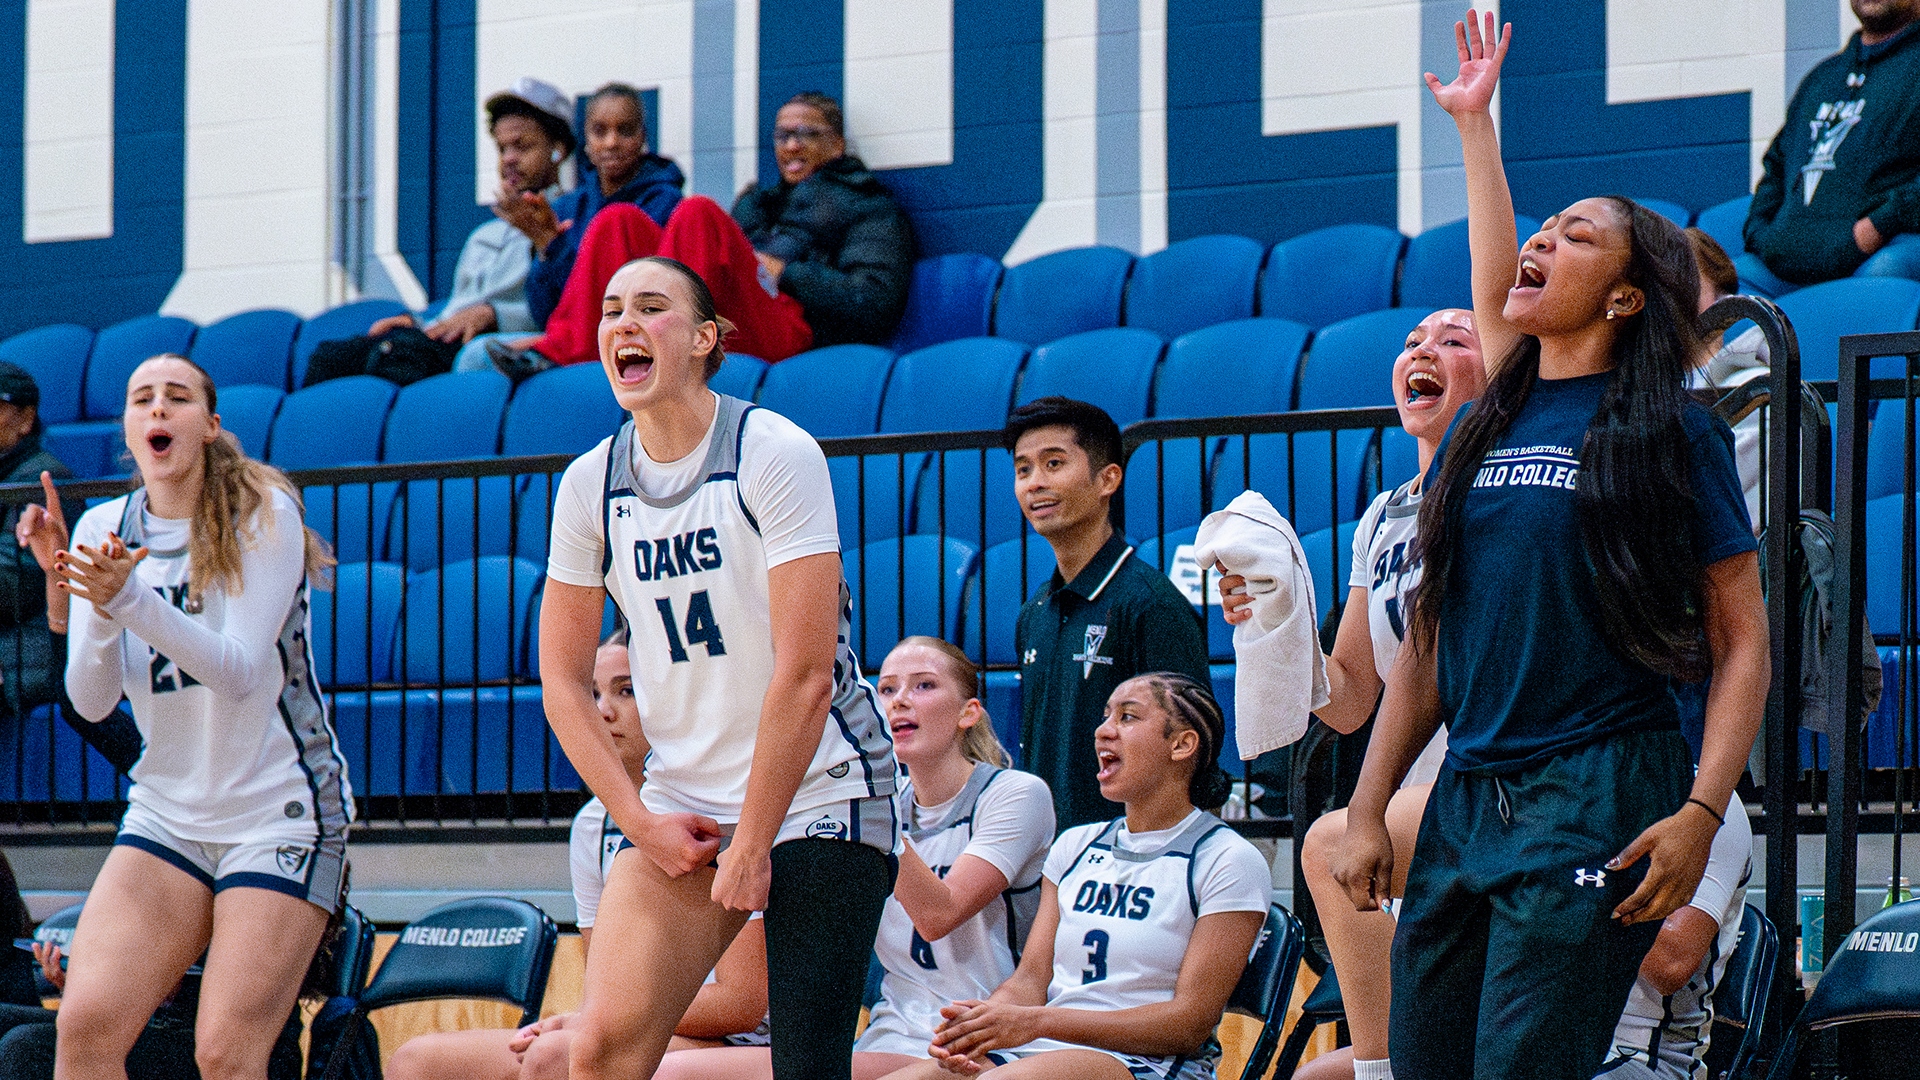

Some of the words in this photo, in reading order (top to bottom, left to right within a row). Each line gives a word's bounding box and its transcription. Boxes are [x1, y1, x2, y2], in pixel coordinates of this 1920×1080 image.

[1519, 445, 1574, 456] BASKETBALL
[1473, 465, 1509, 488] NLO
[1508, 464, 1577, 490] COLLEG
[634, 527, 722, 581] OAKS
[654, 589, 727, 664] 14
[816, 822, 837, 831] OAKS
[1072, 879, 1155, 921] OAKS
[401, 926, 460, 946] MENLO
[460, 926, 528, 947] COLLEGE
[1846, 931, 1919, 953] MENLO
[1081, 928, 1110, 985] 3
